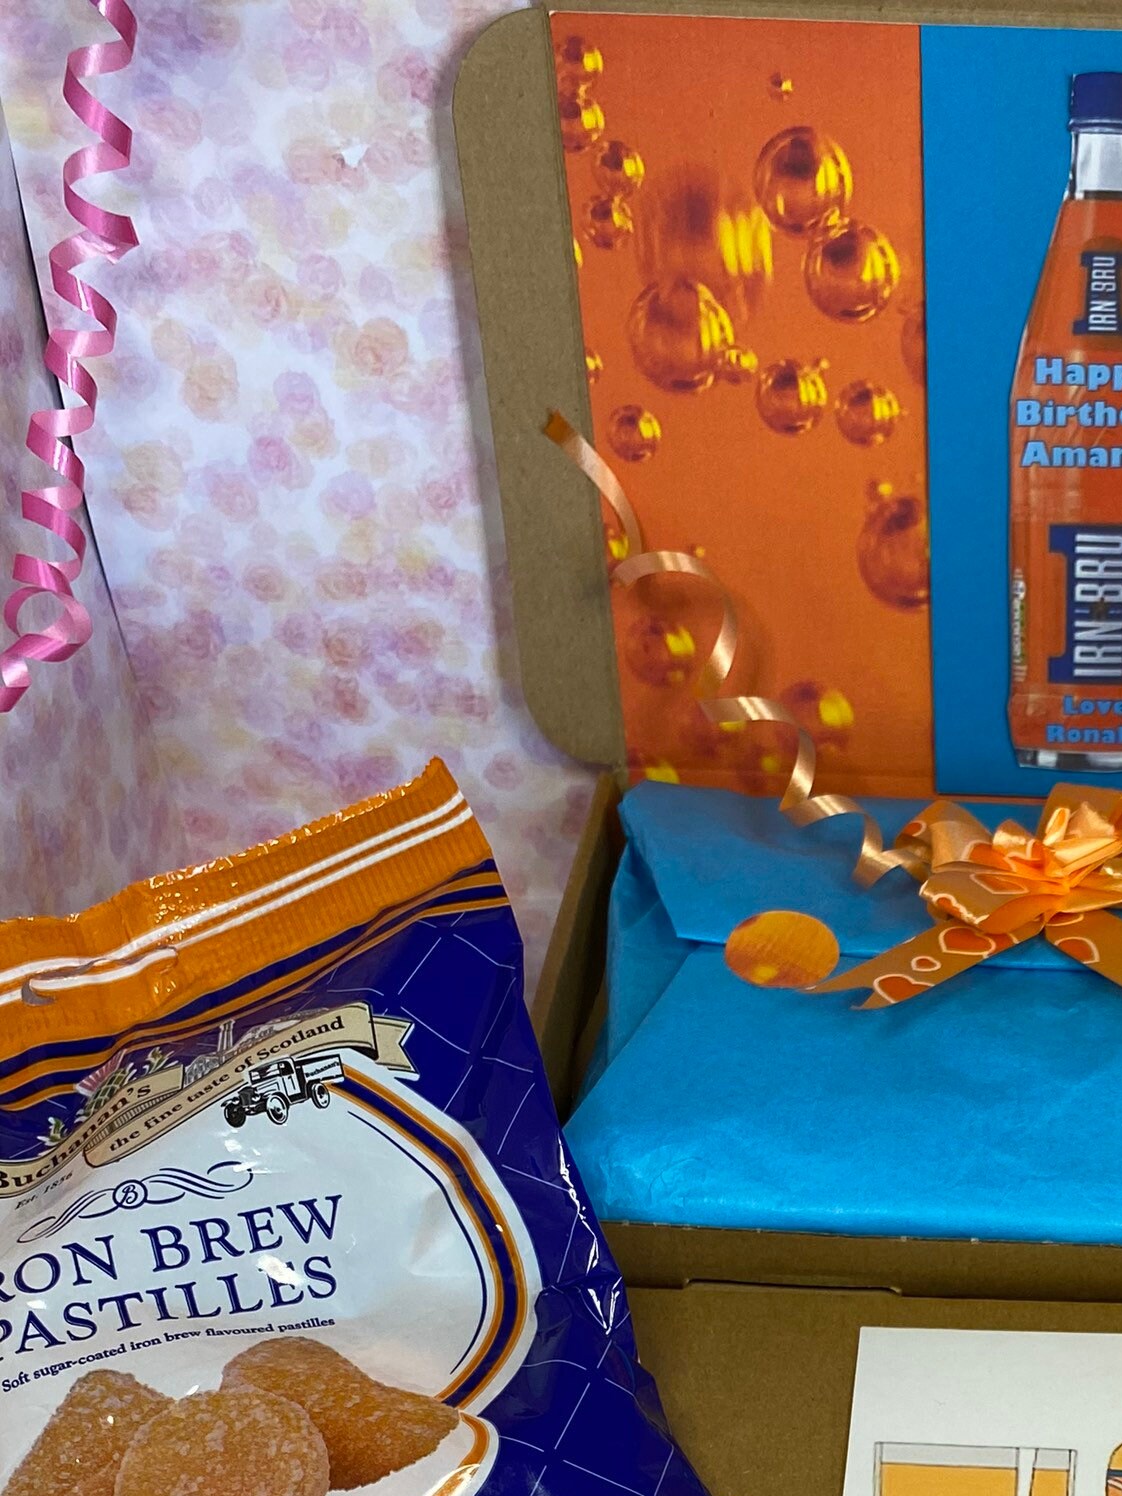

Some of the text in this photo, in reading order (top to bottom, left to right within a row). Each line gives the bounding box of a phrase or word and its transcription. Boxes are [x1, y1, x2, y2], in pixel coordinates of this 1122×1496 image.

[1088, 256, 1117, 331] IRN BRU
[109, 1016, 345, 1151] the fine taste of Scotland
[0, 1194, 342, 1303] ON BREW
[2, 1317, 335, 1393] Soft sugar-coated iron brew flavoured pastilles
